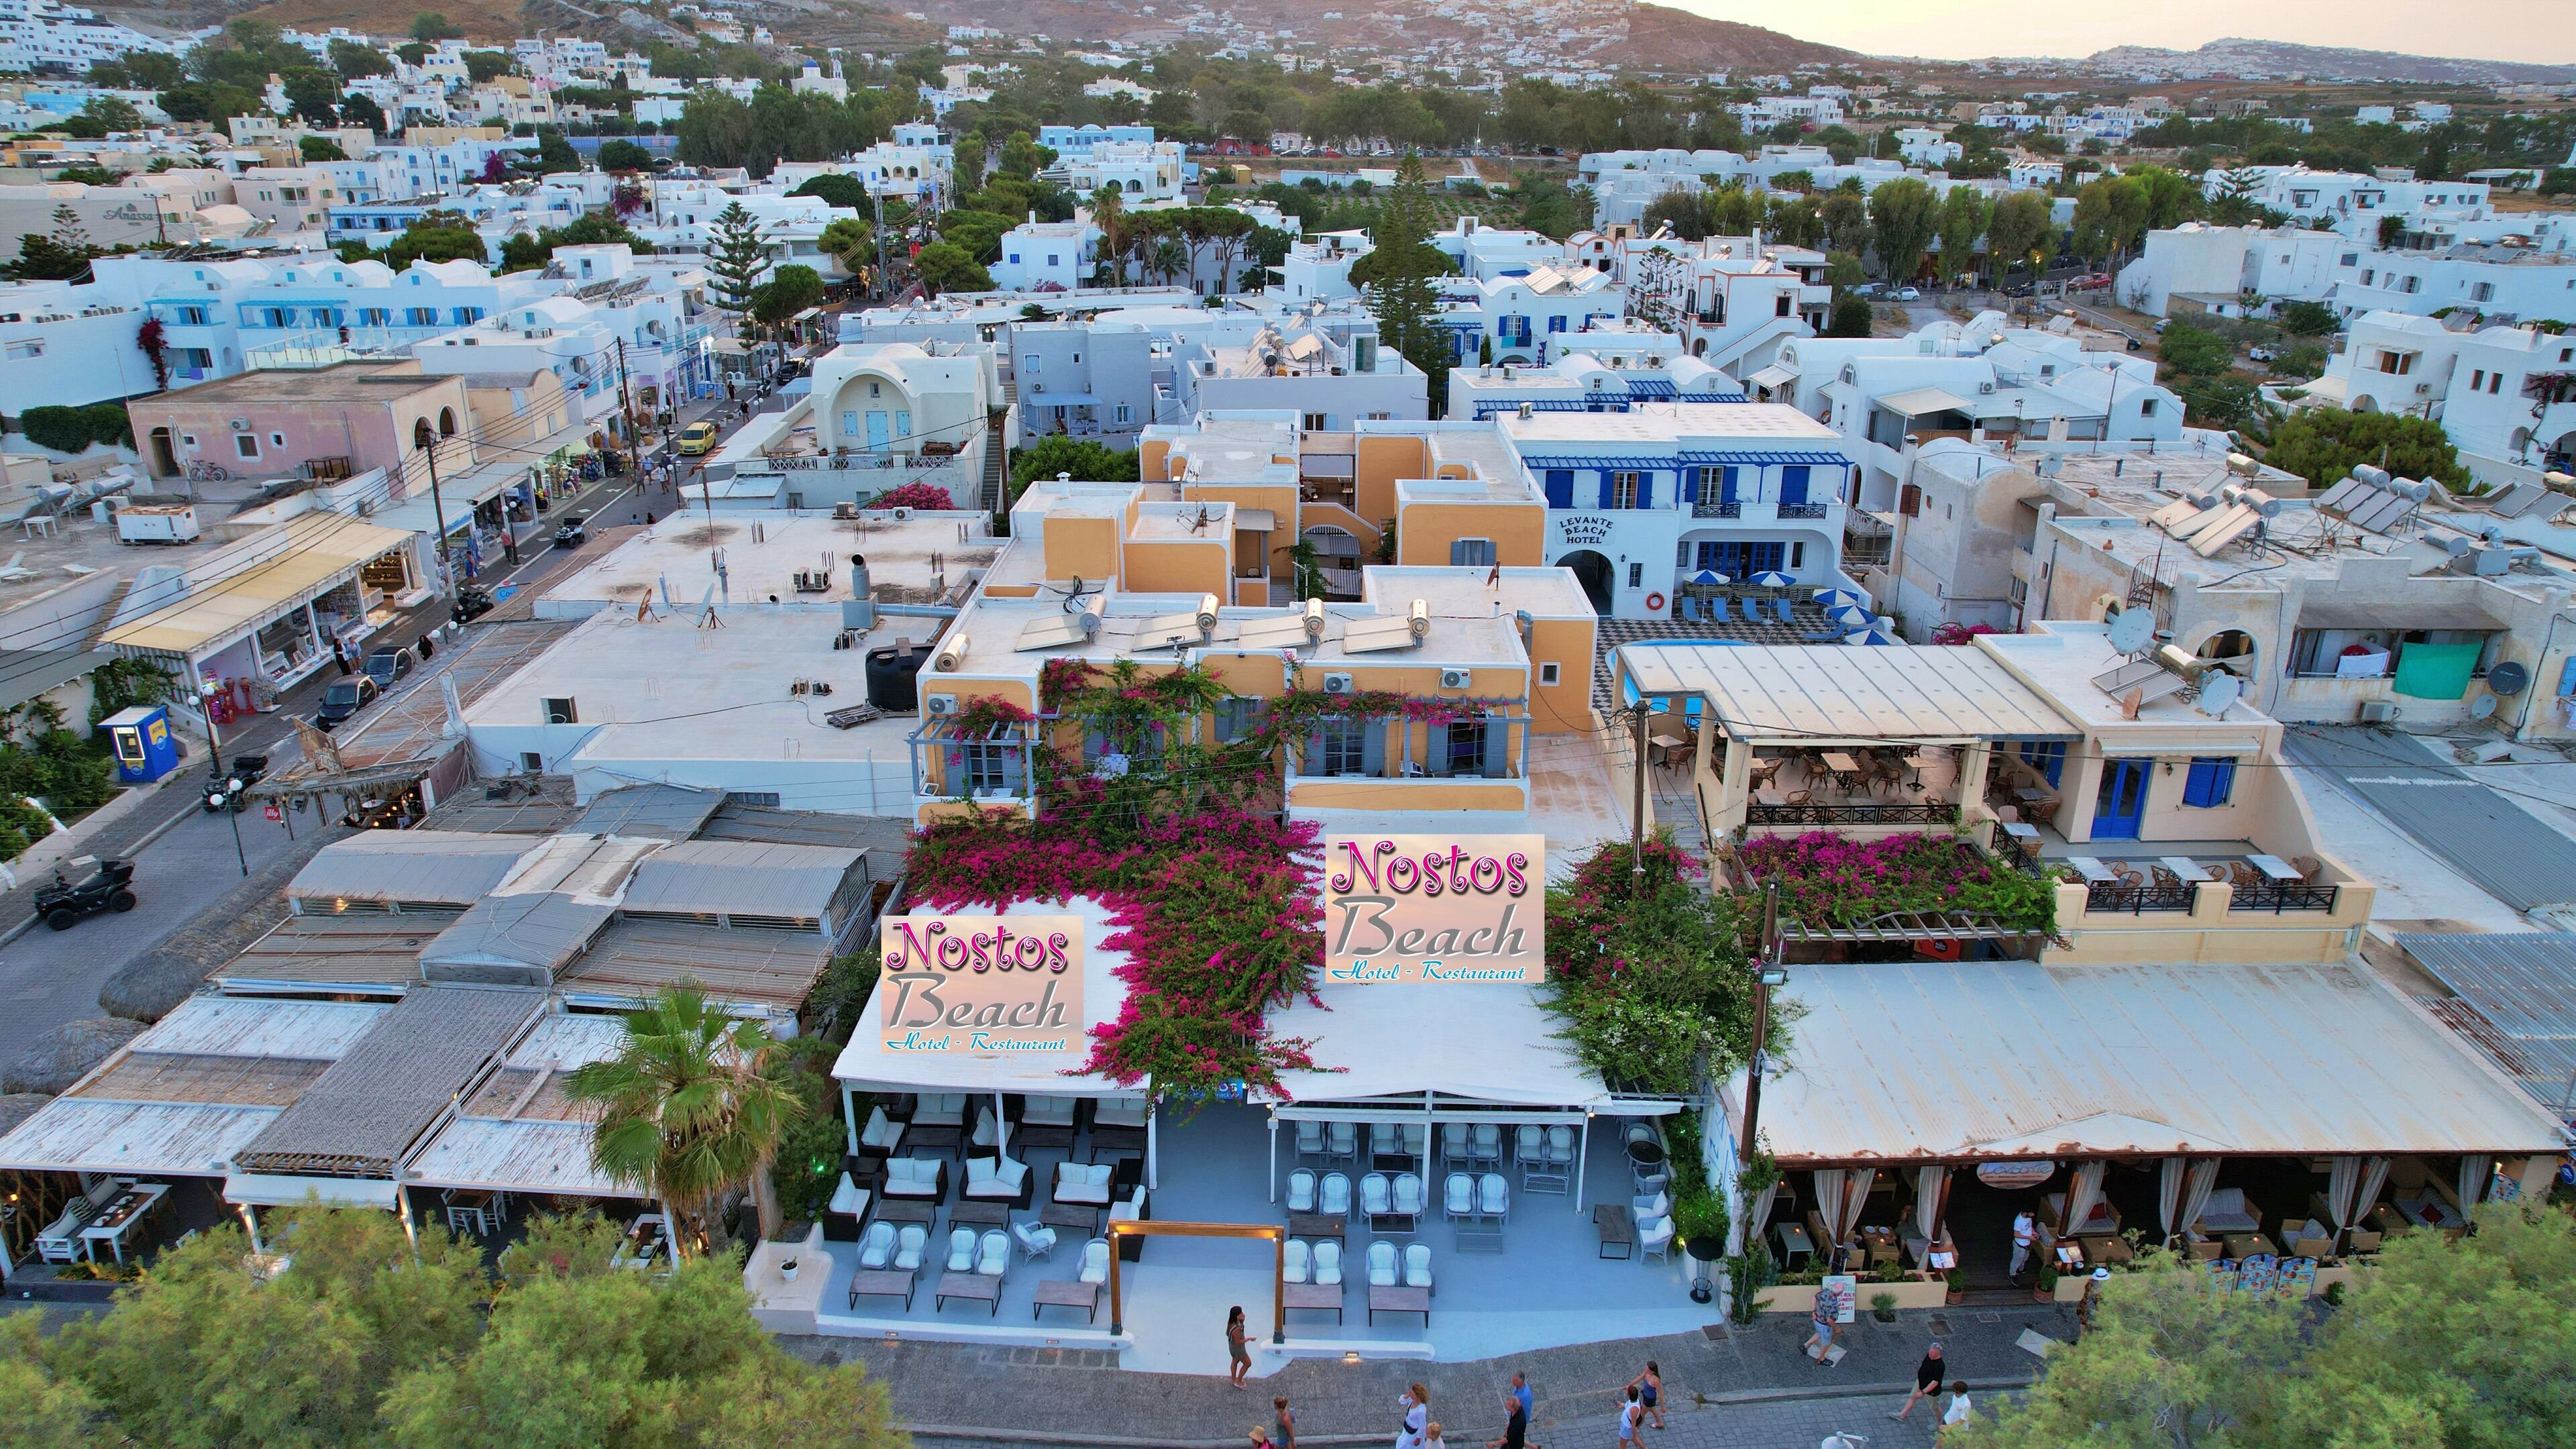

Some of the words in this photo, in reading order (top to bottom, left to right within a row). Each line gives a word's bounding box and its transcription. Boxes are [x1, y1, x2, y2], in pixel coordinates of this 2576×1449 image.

[103, 206, 154, 221] Anassa
[1560, 516, 1613, 529] LEVANTE
[1564, 525, 1607, 537] BEACH
[267, 808, 278, 818] illy
